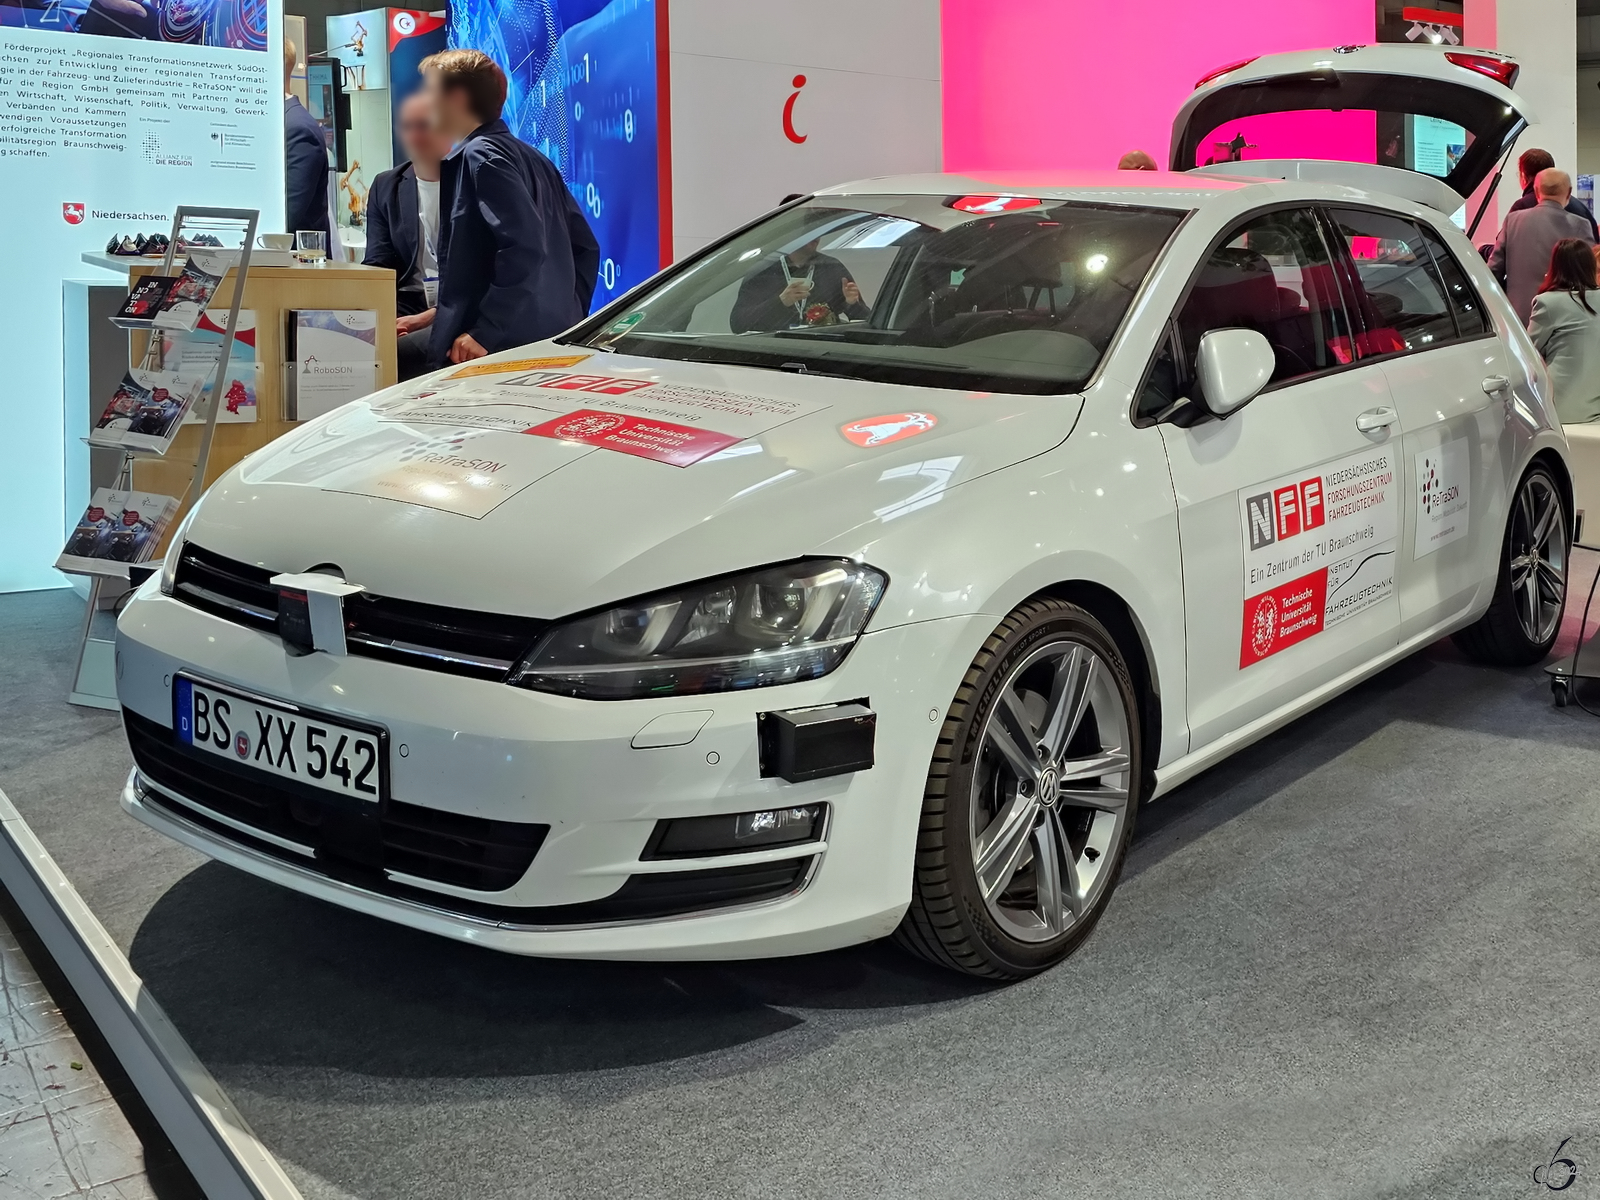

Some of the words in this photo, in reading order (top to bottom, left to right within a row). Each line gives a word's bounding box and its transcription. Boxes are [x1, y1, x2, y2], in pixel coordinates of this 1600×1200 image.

[4, 43, 66, 55] Förderprojekt
[128, 54, 233, 70] Transformationsnetzwerk
[238, 64, 267, 73] SüdOst-
[47, 70, 91, 81] Fahrzeug-
[114, 75, 182, 87] Zulieferindustrie
[60, 60, 118, 72] Entwicklung
[125, 65, 148, 74] einer
[155, 69, 203, 78] regionalen
[210, 73, 267, 83] Transformati-
[42, 81, 73, 90] Region
[116, 88, 165, 97] gemeinsam
[193, 93, 228, 102] Partnern
[6, 102, 56, 111] Verbänden
[85, 107, 126, 116] Kammern
[16, 91, 66, 101] Wirtschaft,
[74, 95, 133, 106] Wissenschaft,
[141, 100, 170, 110] Politik,
[235, 107, 268, 116] Gewerk-
[1, 125, 56, 134] erfolgreiche
[60, 128, 127, 139] Transformation
[50, 116, 127, 128] Voraussetzungen
[9, 149, 50, 157] schaffen.
[64, 140, 127, 152] Braunschweig-
[92, 210, 170, 222] Niedersachsen.
[496, 372, 658, 395] NFF
[600, 400, 702, 422] Braunschweig
[619, 428, 684, 446] Universität
[633, 423, 695, 441] Technische
[604, 434, 683, 457] Braunschweig
[418, 452, 507, 473] ReTraSON
[1326, 457, 1388, 487] NIEDERSÄCHSISCHES
[1328, 472, 1392, 504] FORSCHUNGSZENTRUM
[1433, 484, 1460, 507] ReTraSON
[1248, 477, 1323, 548] NFF
[1328, 491, 1386, 522] FAHRZEUGTECHNIK
[1251, 569, 1264, 584] Ein
[1267, 556, 1300, 577] Zentrum
[1302, 550, 1314, 563] der
[1316, 543, 1326, 558] TU
[1330, 525, 1374, 552] Braunschweig
[1282, 588, 1312, 608] Technische
[1325, 577, 1392, 616] FAHRZEUGTECHNIK
[1281, 602, 1311, 623] Universität
[1280, 613, 1317, 638] Braunschweig
[1012, 638, 1028, 656] PILOT
[1028, 627, 1046, 642] SPORT
[969, 659, 1010, 740] MICHELIN
[182, 717, 188, 731] D
[194, 690, 231, 750] BS
[254, 710, 297, 774] XX
[307, 724, 377, 795] 542
